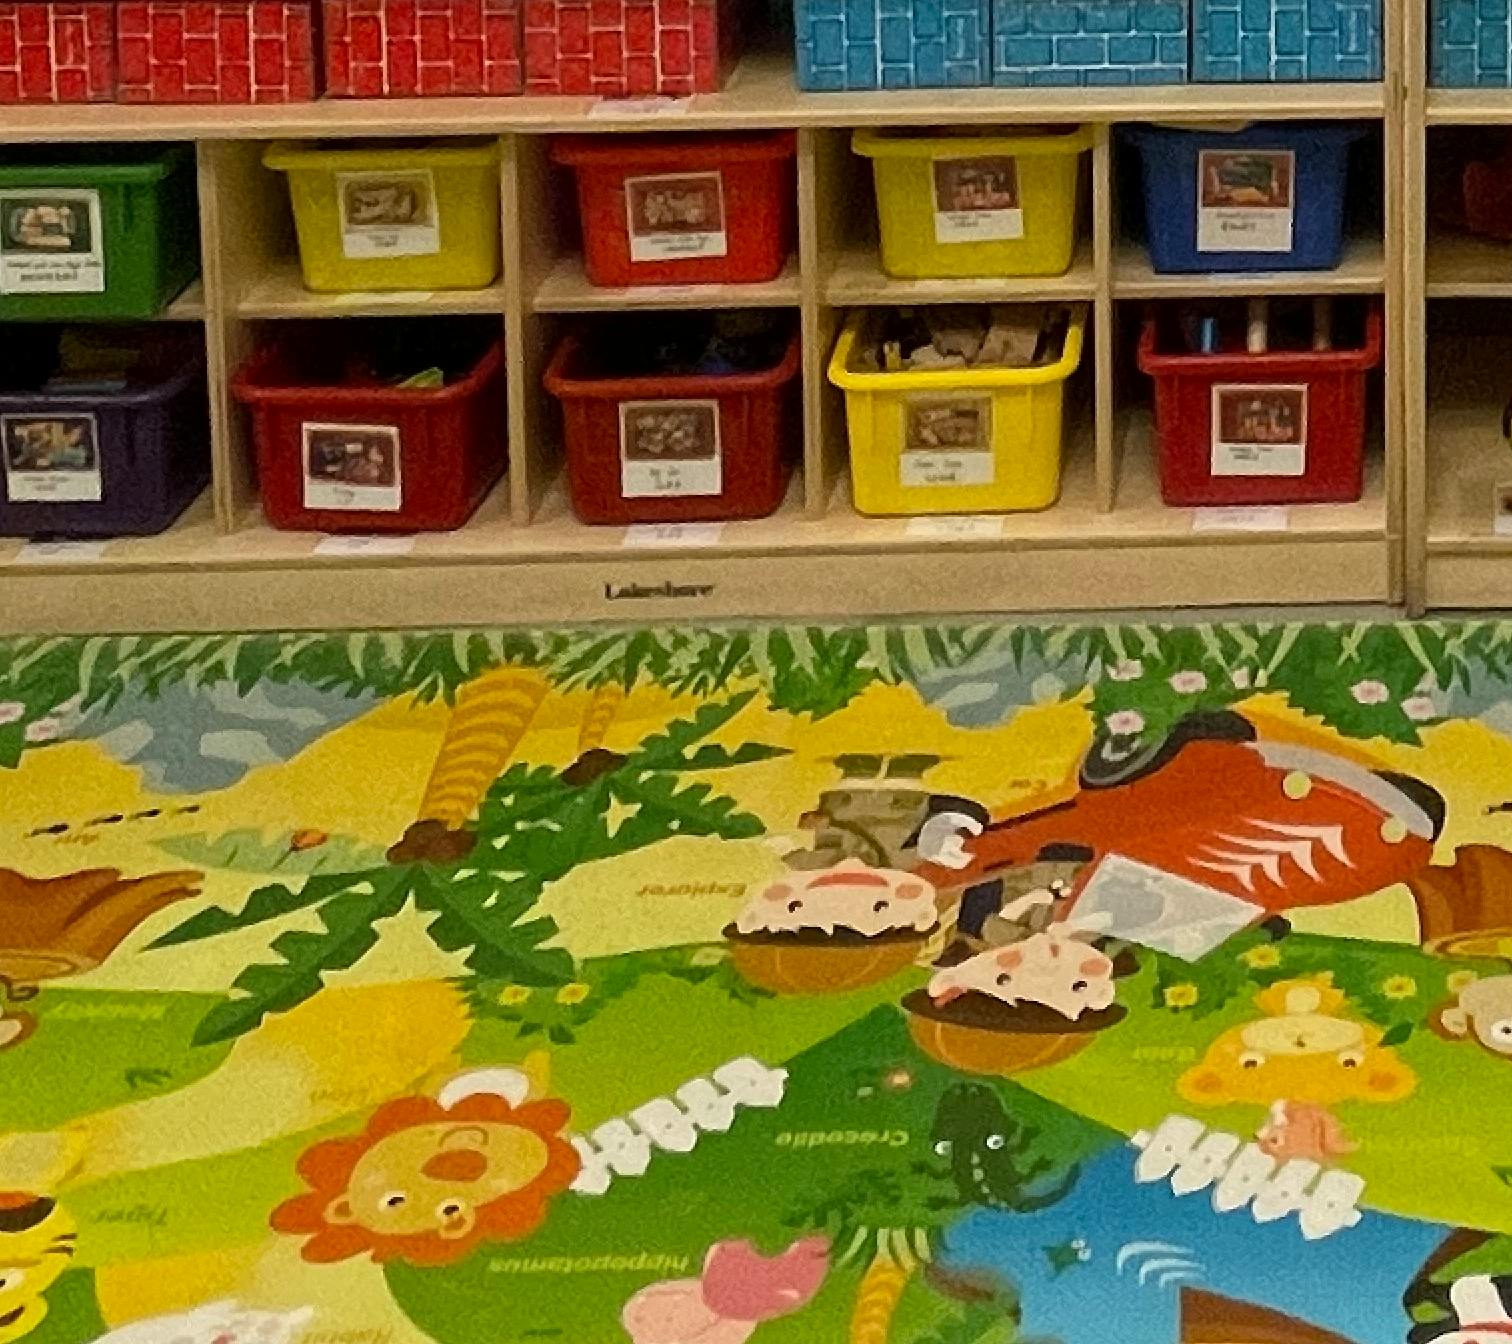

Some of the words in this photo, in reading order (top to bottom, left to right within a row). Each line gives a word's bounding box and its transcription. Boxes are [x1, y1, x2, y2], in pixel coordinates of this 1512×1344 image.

[635, 881, 747, 898] Explorer
[774, 1130, 911, 1150] Crocodile
[487, 1252, 690, 1274] hippopotamus
